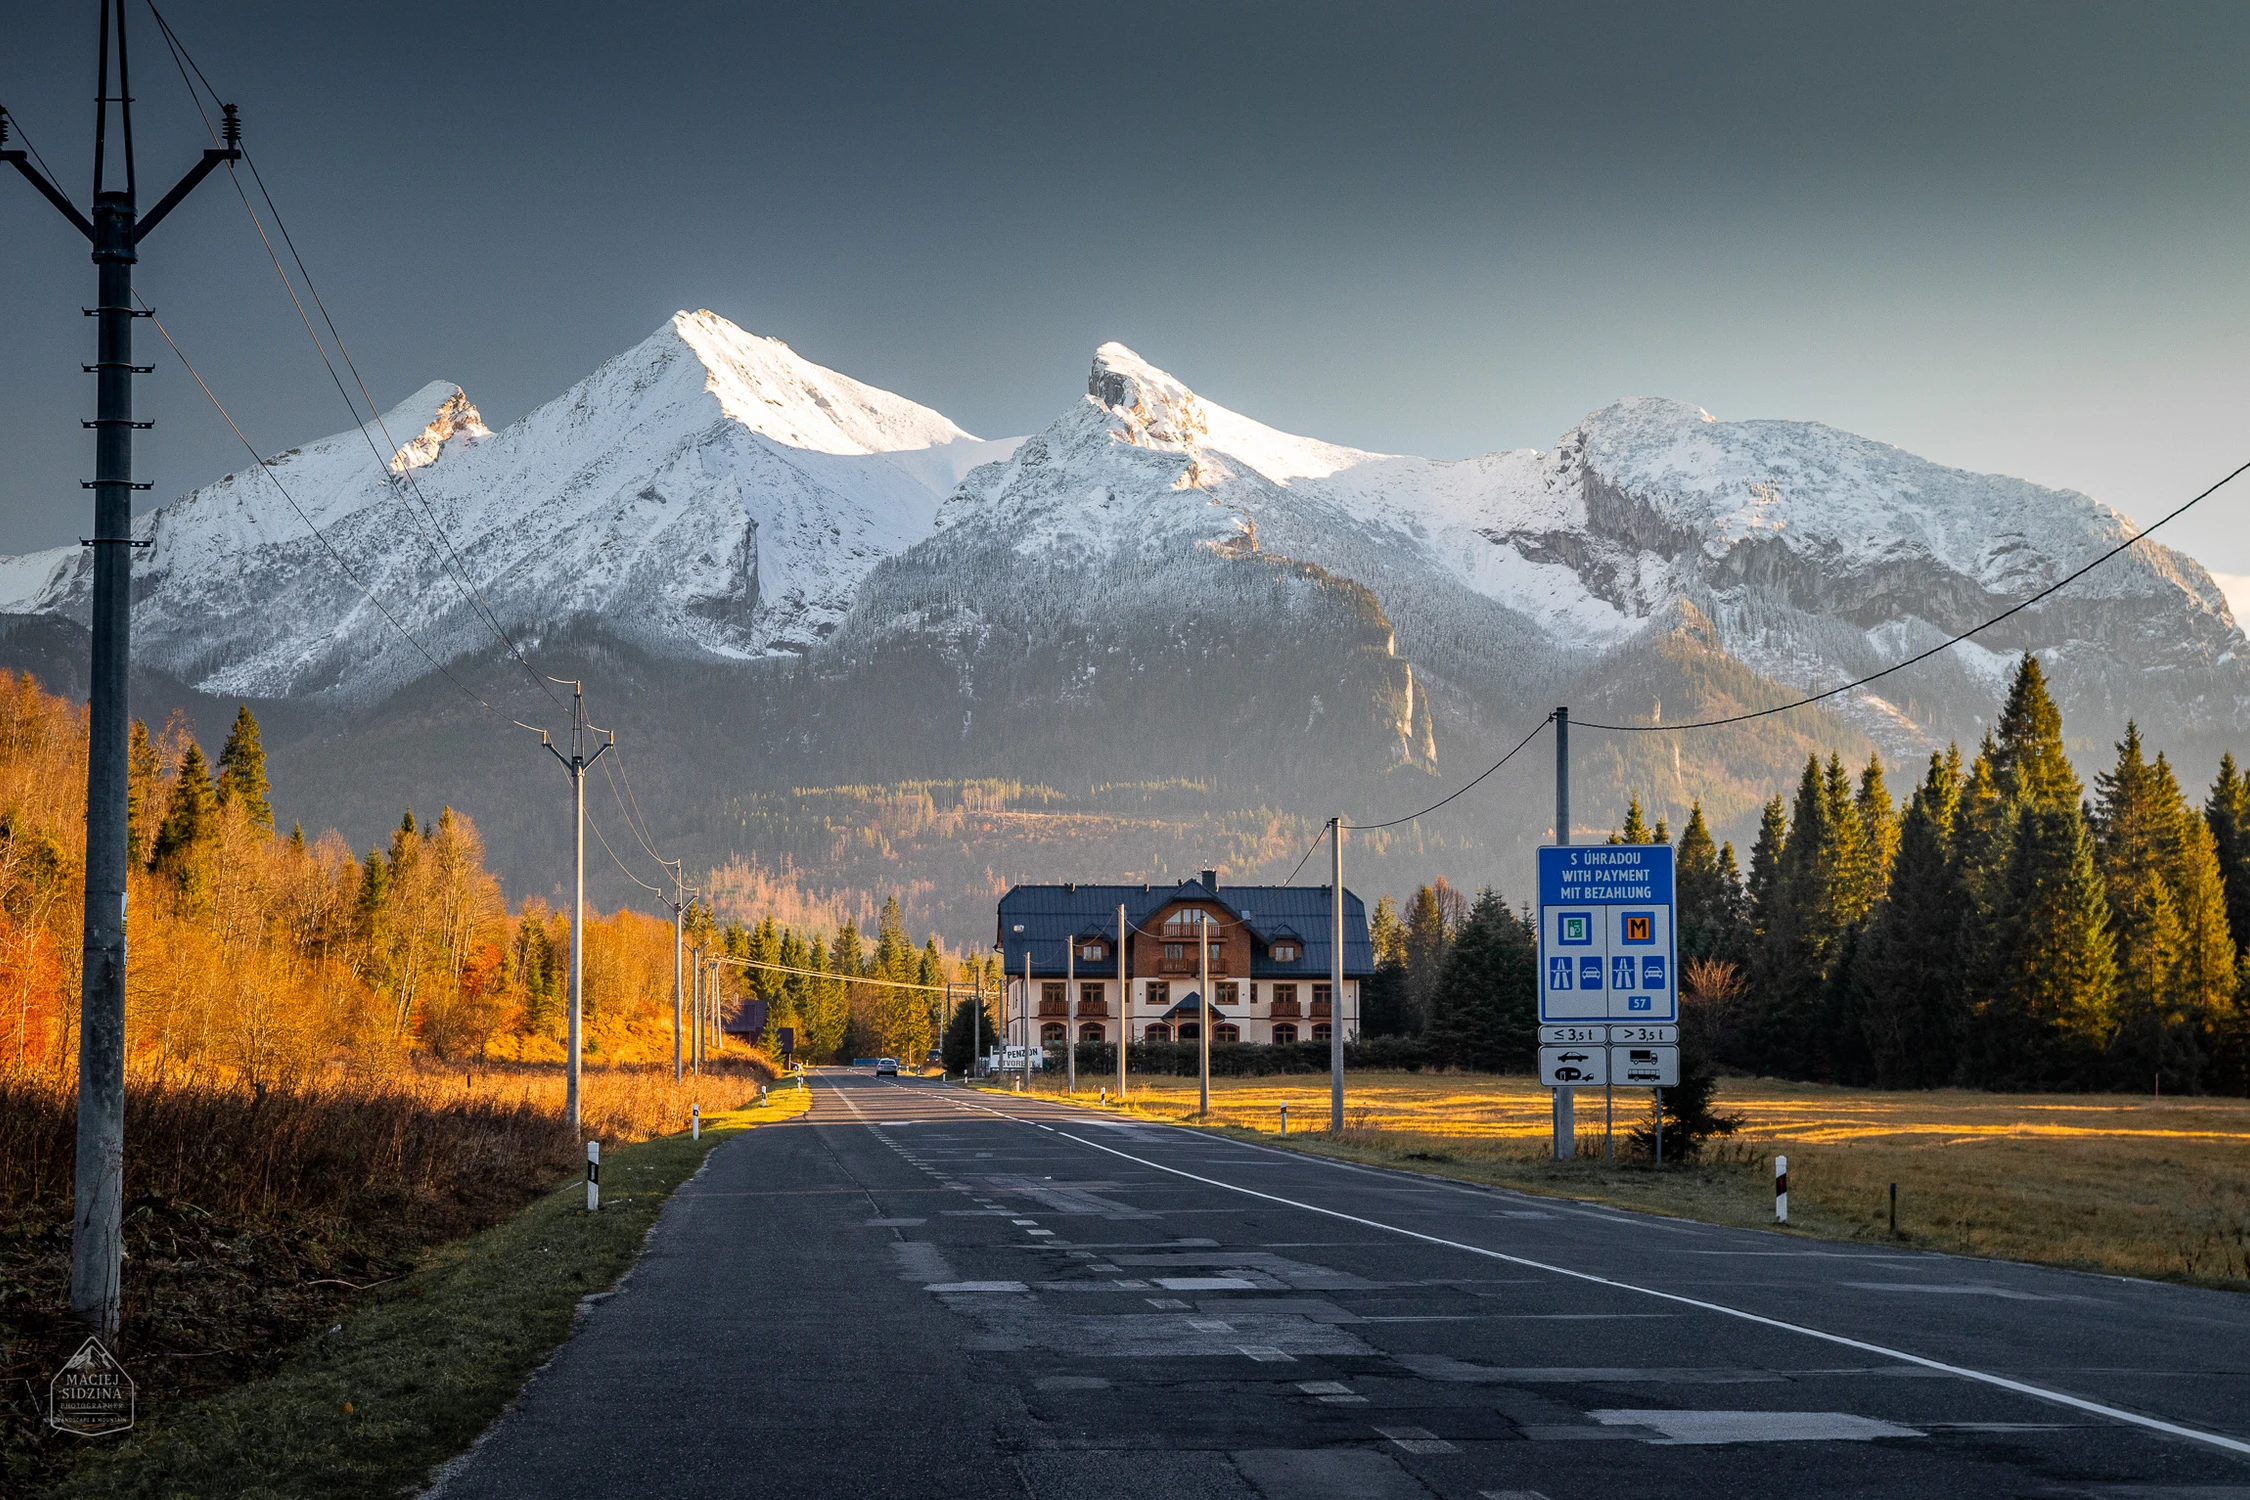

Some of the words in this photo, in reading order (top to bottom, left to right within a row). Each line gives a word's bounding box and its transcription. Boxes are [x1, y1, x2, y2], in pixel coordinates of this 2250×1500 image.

[1570, 852, 1578, 866] S
[1584, 850, 1641, 865] ÚHRADOU
[1562, 870, 1592, 882] WITH
[1595, 869, 1650, 882] PAYMENT
[1560, 887, 1581, 899] MIT
[1584, 886, 1652, 899] BEZAHLUNG
[1630, 919, 1647, 938] M
[1633, 998, 1646, 1009] 57
